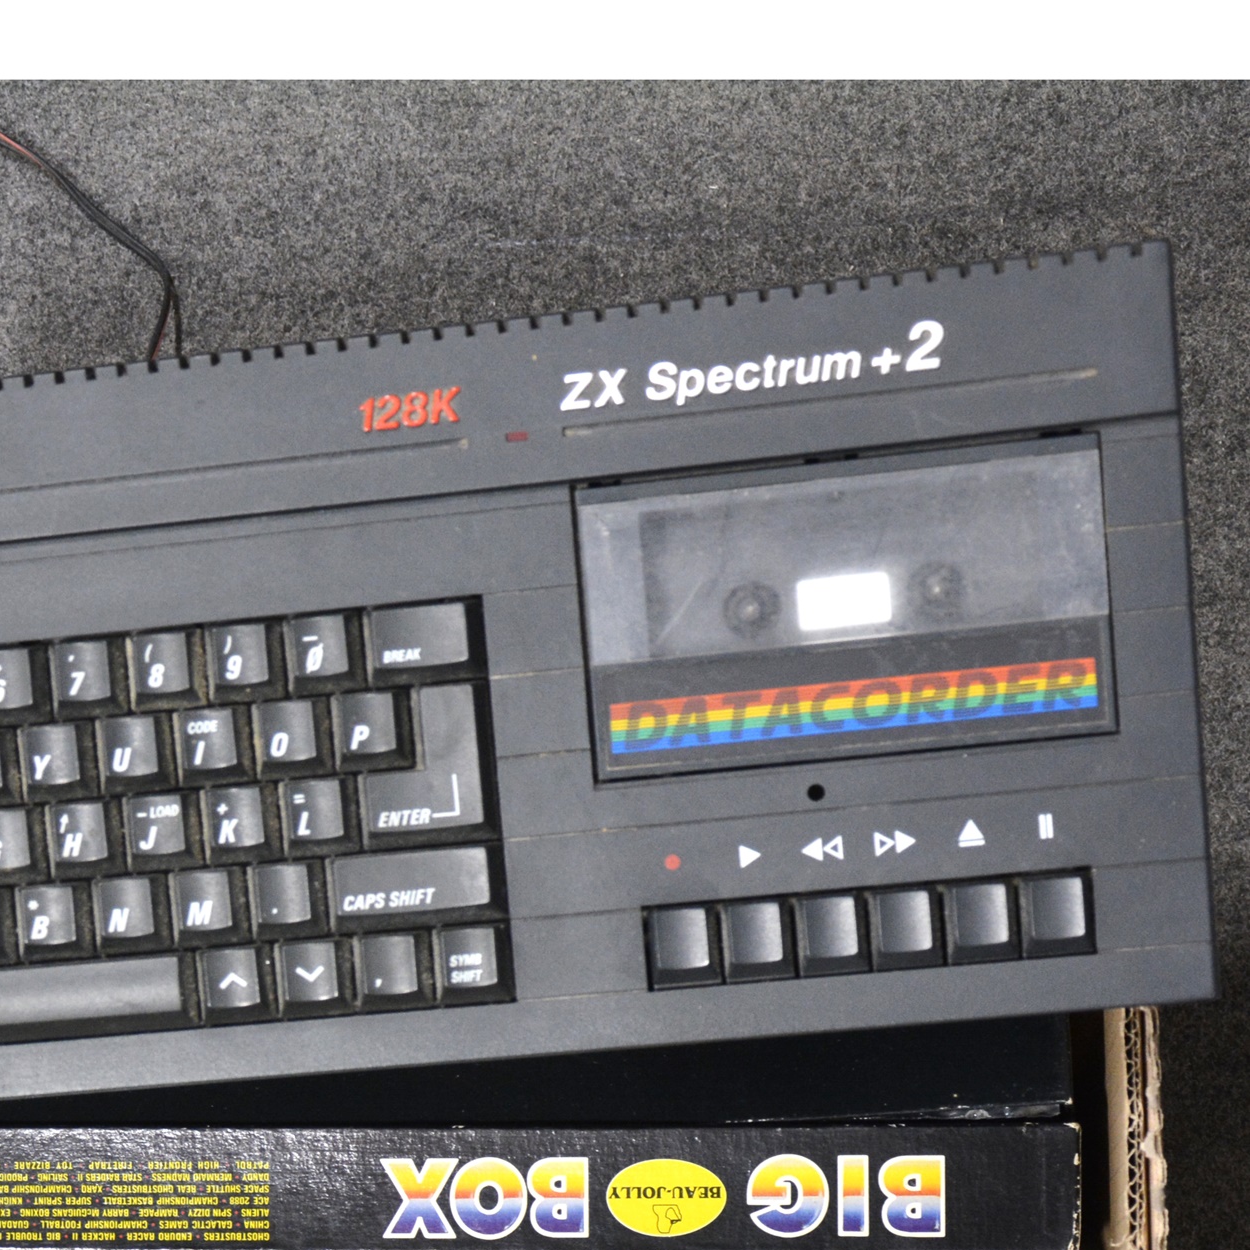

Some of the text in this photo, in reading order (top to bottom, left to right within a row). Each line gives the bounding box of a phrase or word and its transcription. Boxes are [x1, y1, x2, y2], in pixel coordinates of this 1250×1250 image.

[560, 368, 627, 412] ZX
[644, 345, 862, 406] Spectrum
[359, 384, 461, 433] 128K
[382, 648, 421, 664] BREAK
[618, 664, 1091, 753] DATACORDER
[150, 804, 179, 818] LOAD
[378, 809, 431, 828] ENTER
[343, 888, 435, 911] CAPS SHIFT
[450, 954, 483, 968] SYMB
[451, 969, 483, 983] SHIFT
[381, 1152, 946, 1240] BIG BOX
[608, 1185, 722, 1201] BEAU-JOLLY
[241, 1209, 269, 1217] ALIENS
[40, 1221, 82, 1229] FOOTBALL
[159, 1221, 189, 1229] GAMES
[191, 1221, 233, 1229] GALACTIC
[244, 1221, 270, 1229] CHINA
[5, 1232, 43, 1241] TROUBLE
[81, 1232, 116, 1241] HACKER
[127, 1232, 156, 1241] RACER
[158, 1232, 192, 1241] ENDURO
[203, 1232, 270, 1241] GHOSTBUSTERS
